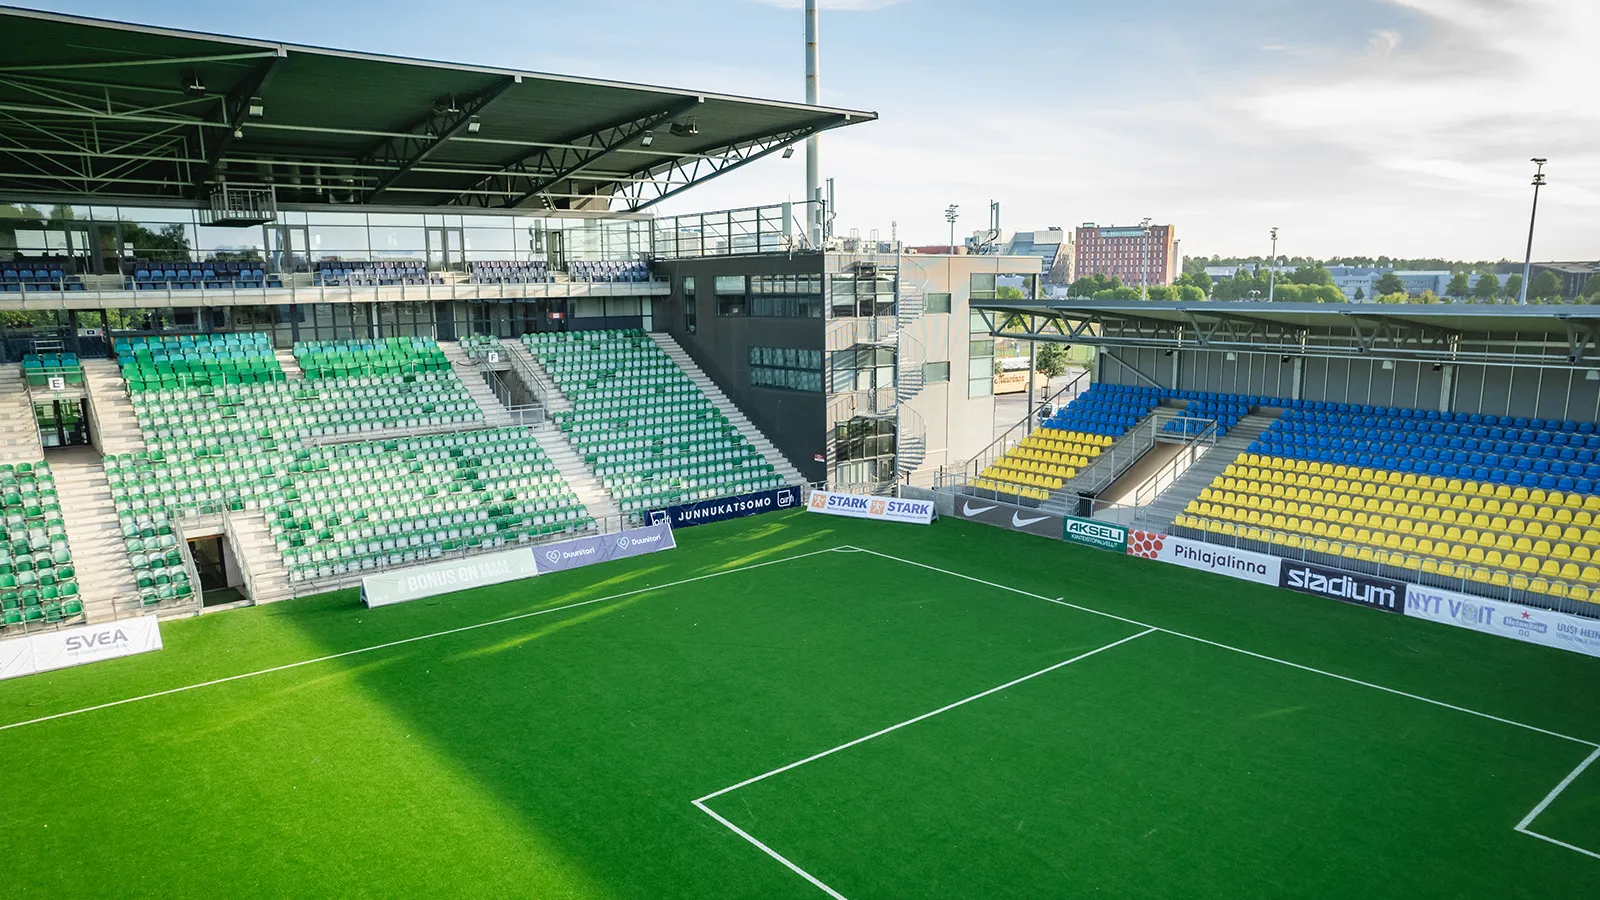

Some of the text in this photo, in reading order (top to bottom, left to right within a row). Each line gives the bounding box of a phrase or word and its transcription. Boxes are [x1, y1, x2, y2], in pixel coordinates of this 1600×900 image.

[490, 353, 496, 362] F
[52, 379, 61, 388] E
[678, 497, 772, 522] JUNNUKATSOMO
[828, 495, 869, 509] STARK
[887, 501, 930, 515] STARK
[631, 533, 661, 546] Duunitori
[1069, 522, 1122, 541] AKSELI
[562, 546, 596, 560] Duunitori
[1174, 544, 1267, 576] Pihlajalinna
[407, 568, 457, 592] BONUS
[1287, 567, 1396, 608] stadium
[1407, 591, 1443, 614] NYT
[1557, 623, 1578, 635] UUSI
[66, 629, 129, 651] SVEA
